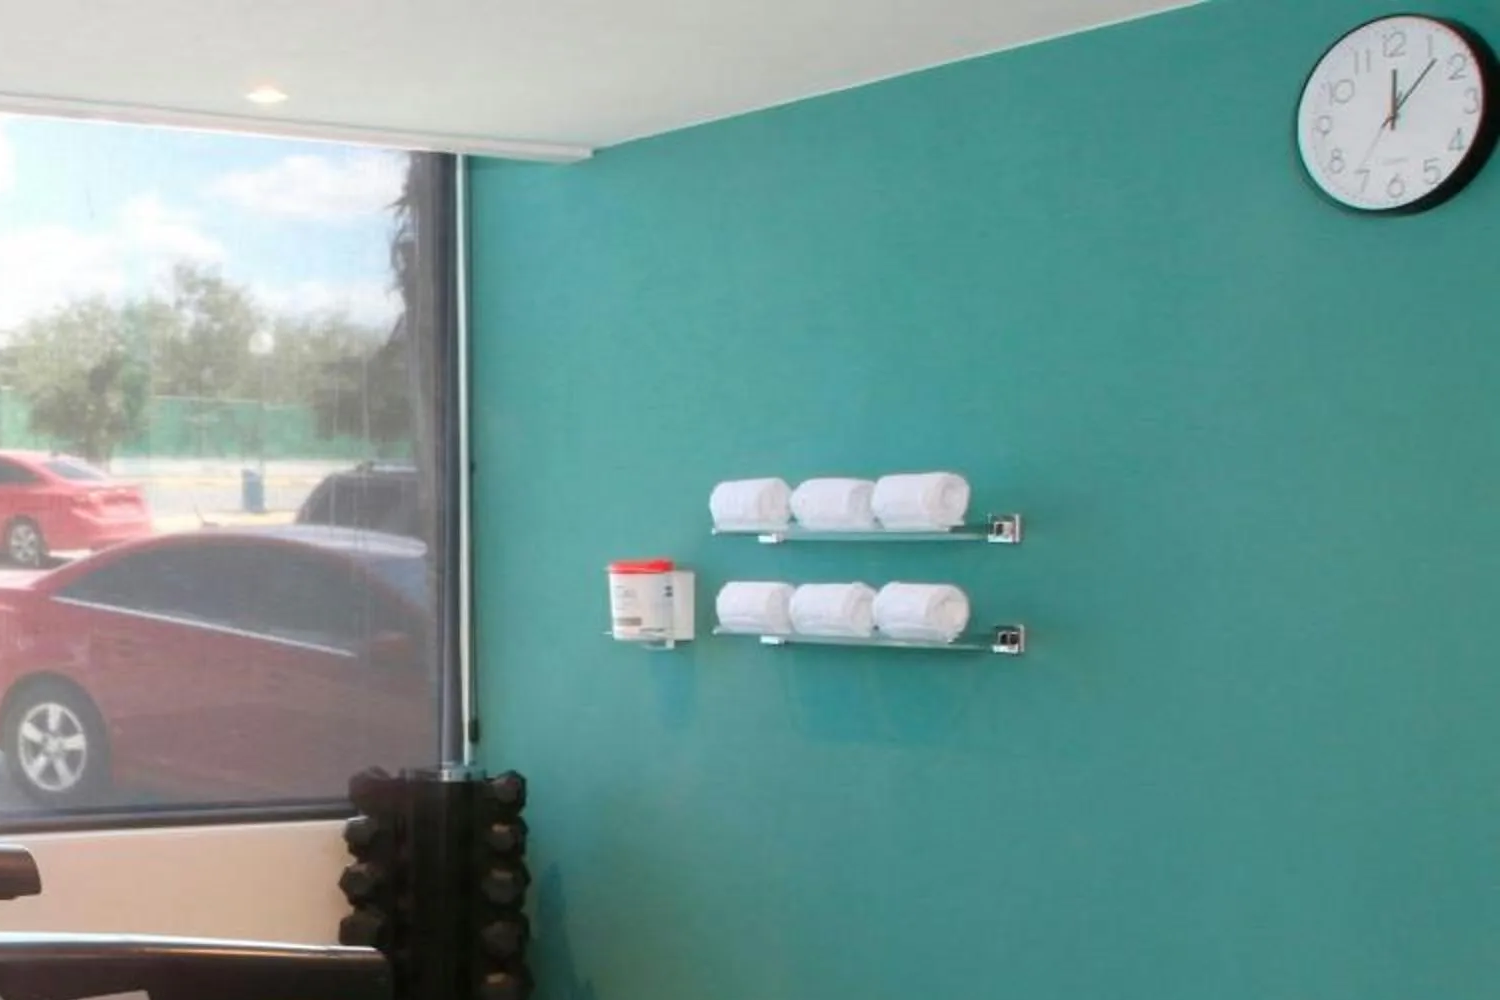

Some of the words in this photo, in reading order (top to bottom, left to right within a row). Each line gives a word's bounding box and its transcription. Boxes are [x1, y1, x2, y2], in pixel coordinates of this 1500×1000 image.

[1382, 31, 1407, 58] 12
[1426, 34, 1434, 57] 1
[1354, 49, 1371, 75] 11
[1448, 53, 1467, 81] 2
[1322, 79, 1355, 105] 10
[1463, 87, 1479, 115] 3
[1315, 115, 1333, 136] 9
[1448, 127, 1465, 152] 4
[1329, 149, 1345, 175] 8
[1423, 157, 1442, 185] 5
[1354, 169, 1371, 194] 7
[1387, 173, 1405, 199] 6
